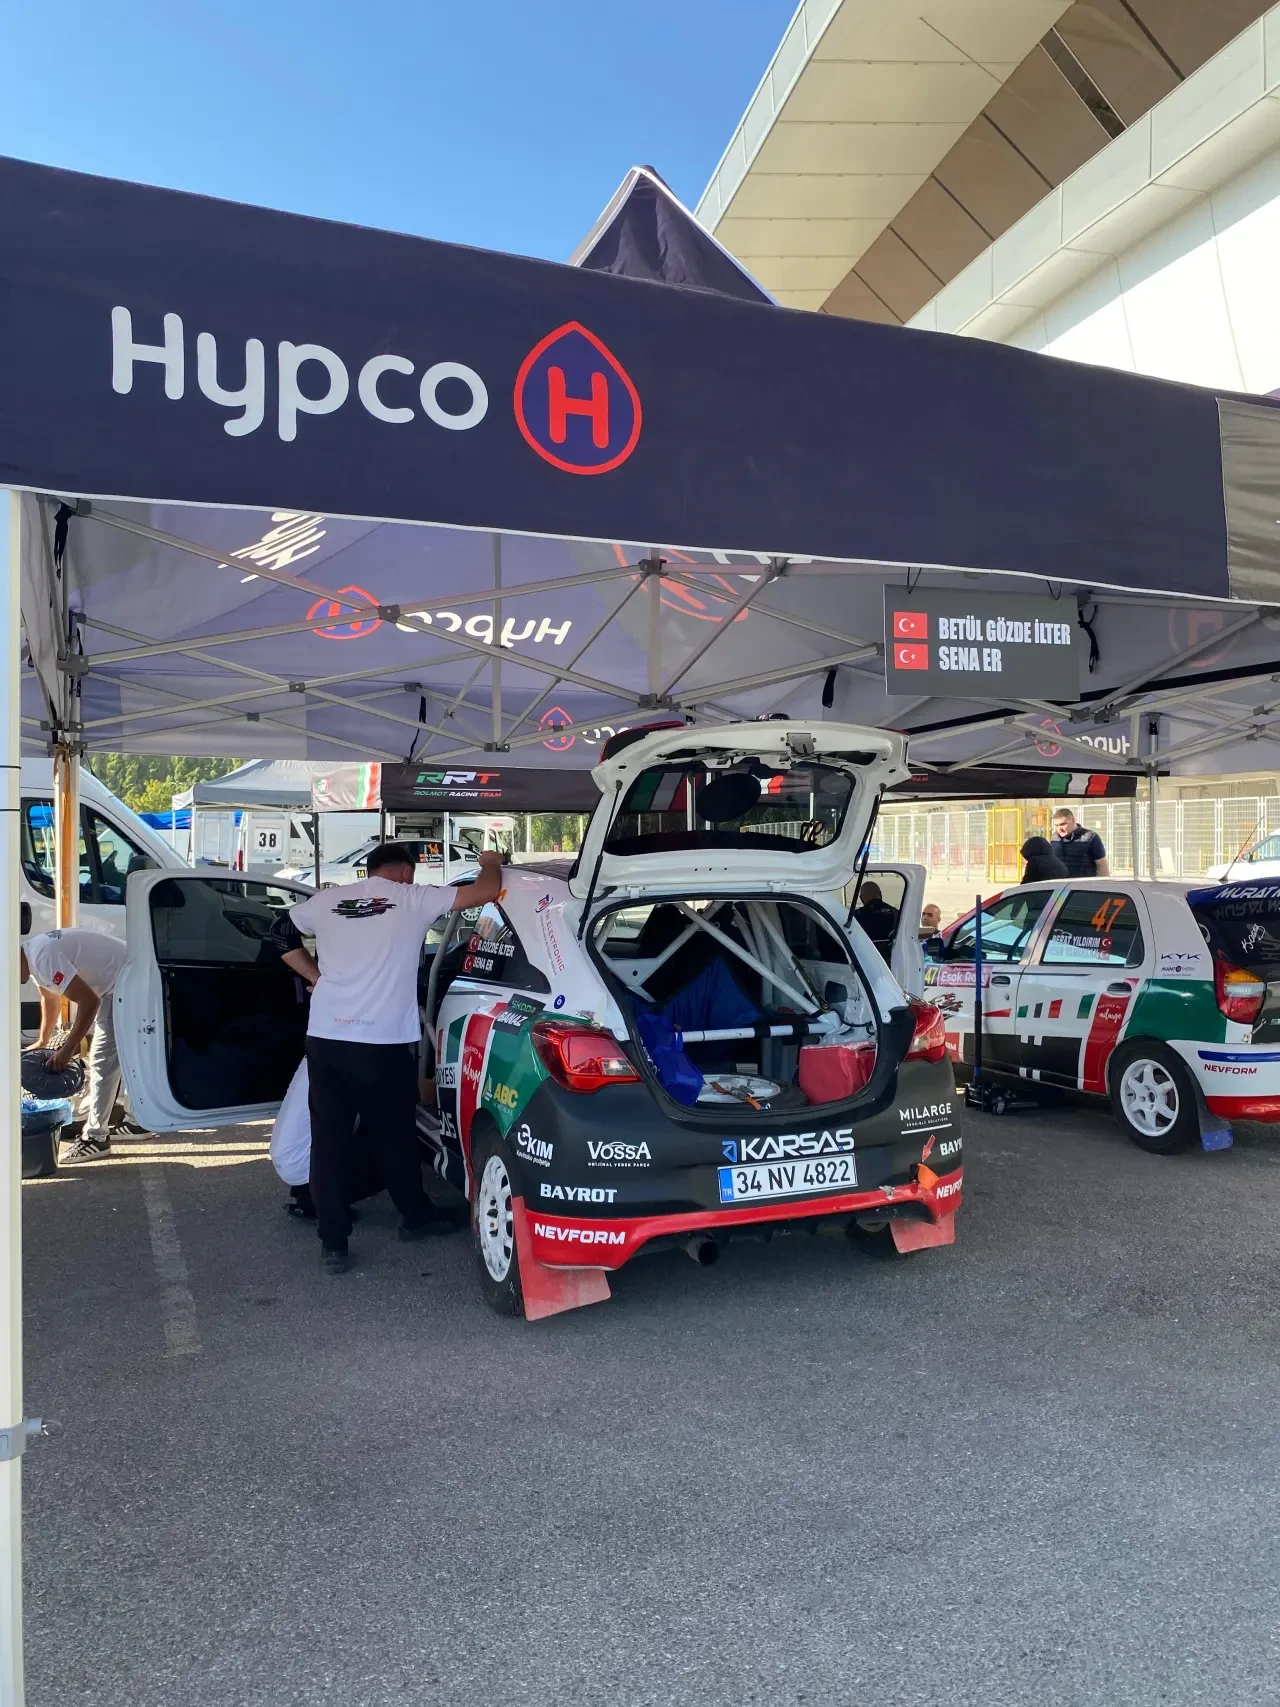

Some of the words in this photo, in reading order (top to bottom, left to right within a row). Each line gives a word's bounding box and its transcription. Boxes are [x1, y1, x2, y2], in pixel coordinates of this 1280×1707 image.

[111, 306, 489, 441] Hypco
[938, 615, 983, 641] BETÜL
[986, 616, 1032, 643] GÖZDE
[1034, 618, 1071, 645] İLTER
[938, 646, 981, 671] SENA
[983, 648, 1002, 672] ER
[416, 771, 500, 784] RRT
[259, 832, 277, 848] 38
[358, 870, 366, 878] 14
[1215, 887, 1278, 899] MURAT
[1091, 898, 1127, 933] 47
[473, 956, 486, 970] SENA
[485, 959, 494, 971] ER
[1161, 952, 1202, 960] KYK
[925, 966, 939, 985] 47
[1204, 1063, 1258, 1075] NEVFORM
[493, 1082, 519, 1109] ABC
[899, 1102, 953, 1121] MILARGE
[741, 1129, 855, 1161] KARSAS
[736, 1169, 762, 1194] 34
[768, 1165, 796, 1191] NV
[803, 1159, 851, 1186] 4822
[540, 1183, 618, 1203] BAYROT
[722, 1188, 733, 1197] TR
[534, 1222, 626, 1245] NEVFORM
